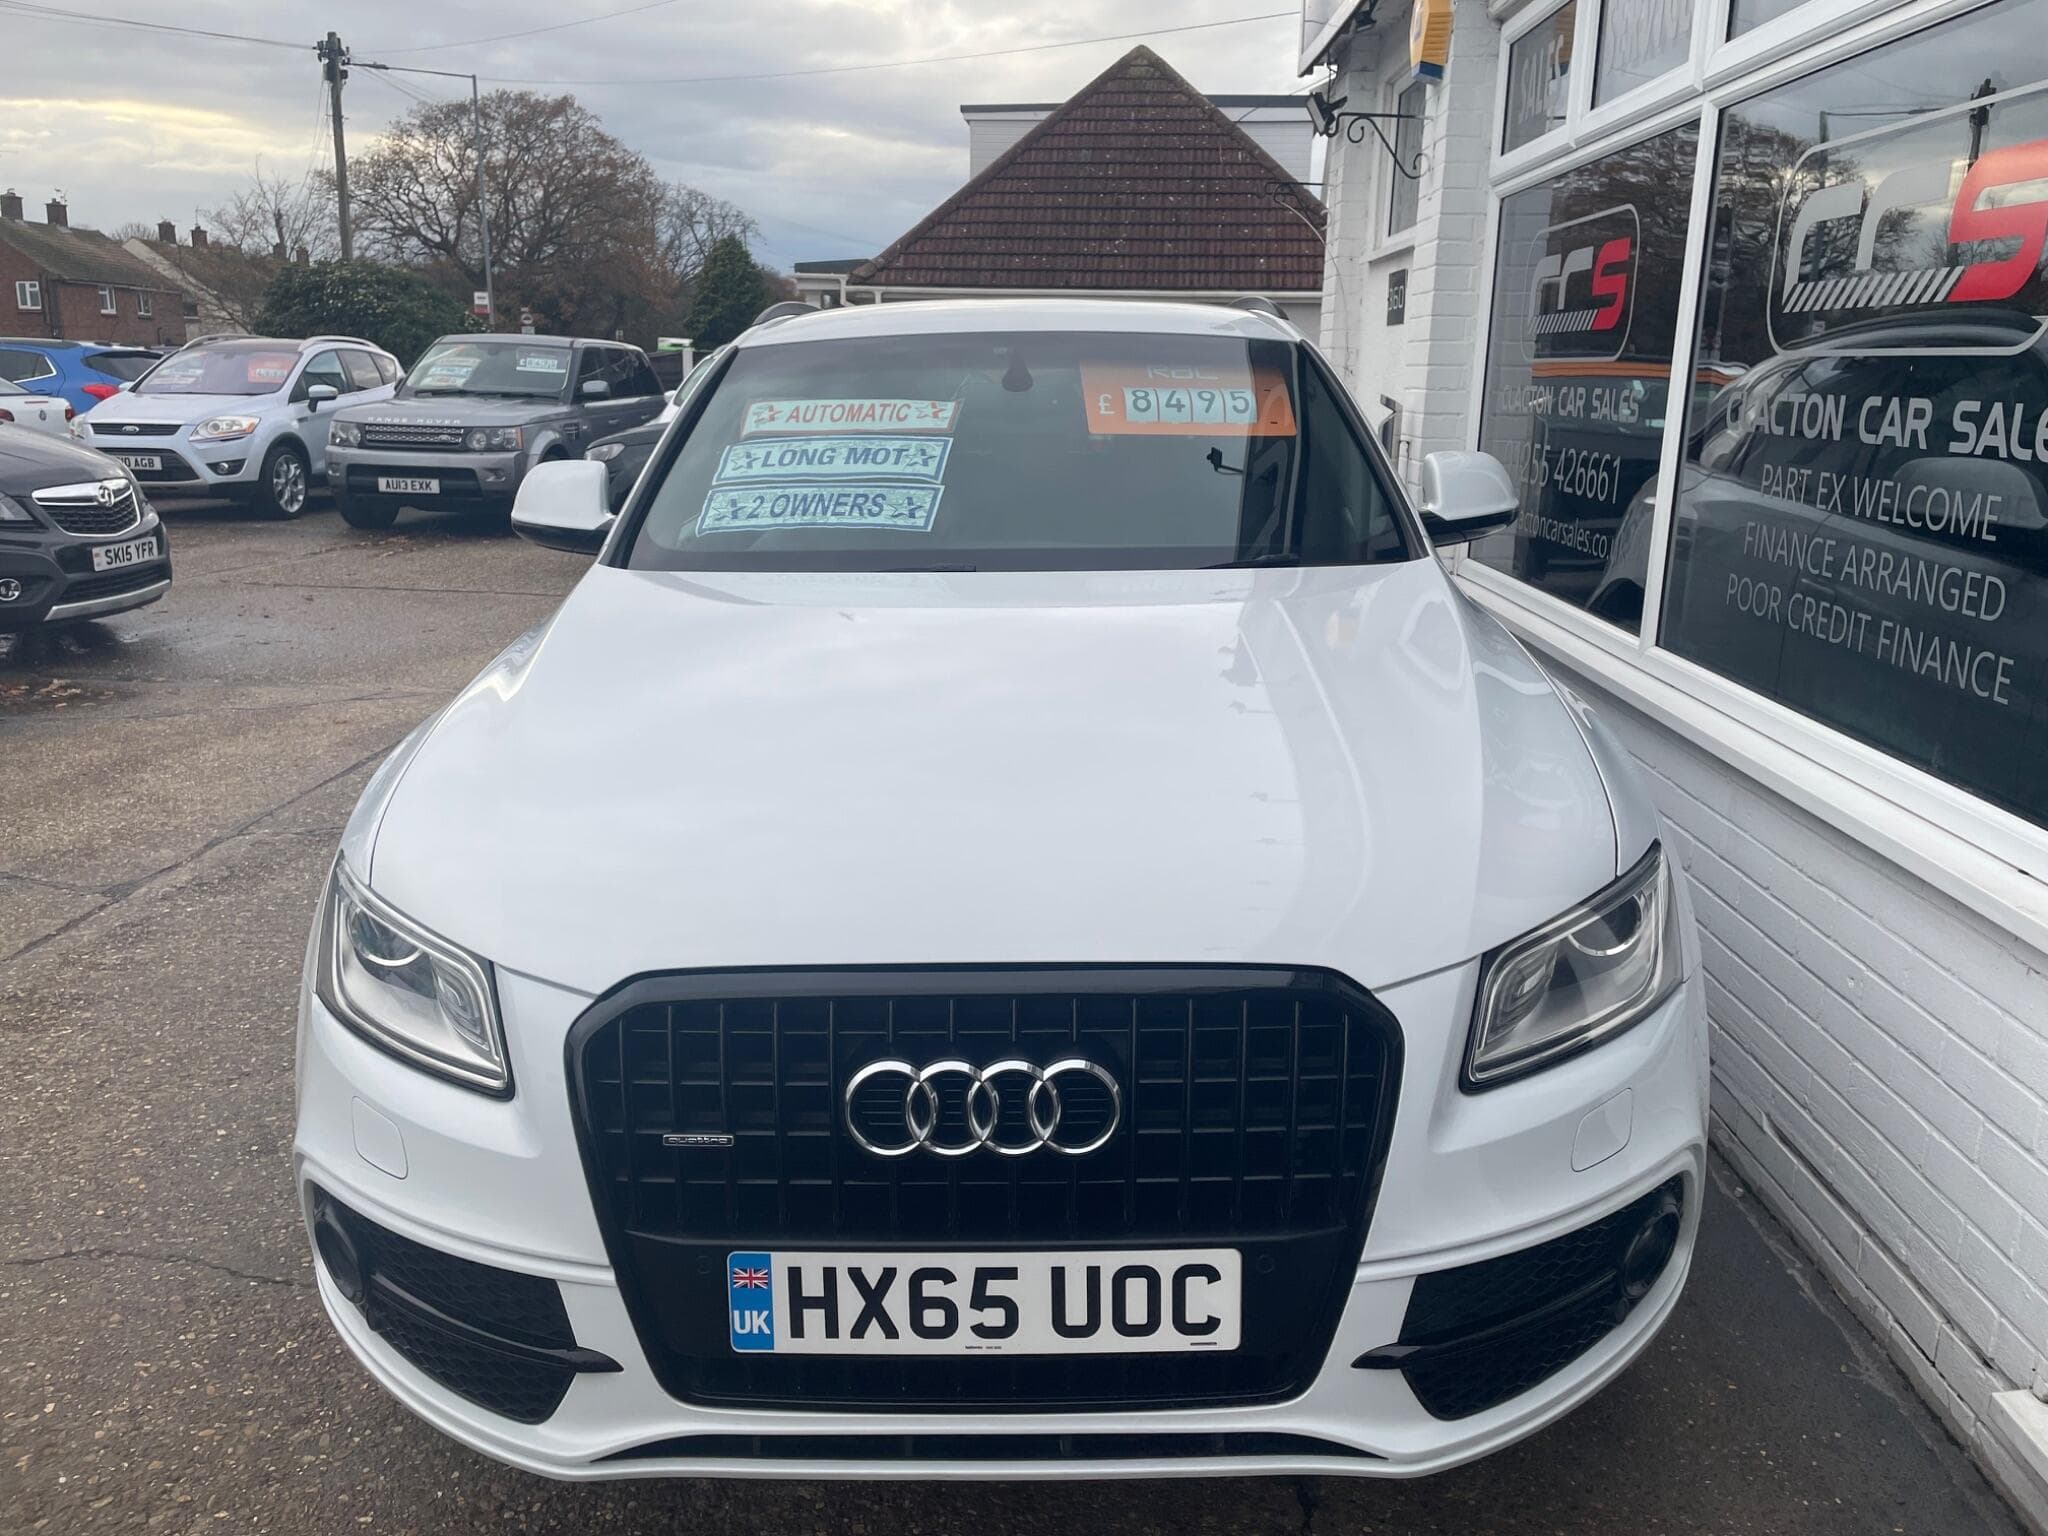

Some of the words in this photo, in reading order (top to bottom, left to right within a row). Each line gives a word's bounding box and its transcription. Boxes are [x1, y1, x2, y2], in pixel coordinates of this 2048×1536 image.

[1388, 285, 1404, 310] 360
[785, 403, 913, 423] AUTOMATIC
[1131, 389, 1251, 413] 8495
[1502, 385, 1554, 414] CLACTON
[1558, 386, 1587, 418] CAR
[1590, 388, 1640, 423] SALES
[1726, 391, 1847, 442] CLACTON
[1858, 396, 1934, 450] CAR
[134, 457, 155, 468] AGB
[760, 448, 836, 468] LONG
[843, 447, 910, 465] MOT
[385, 477, 408, 490] AU13
[411, 479, 432, 491] EXK
[1553, 448, 1622, 504] 426661
[746, 495, 765, 519] 2
[769, 493, 887, 518] OWNERS
[1760, 464, 1812, 505] PART
[1816, 471, 1847, 513] EX
[1854, 476, 2002, 542] WELCOME
[104, 546, 133, 566] SK15
[135, 541, 154, 560] YFR
[1744, 521, 1837, 579] FINANCE
[1840, 545, 2006, 622] ARRANGED
[1726, 573, 1782, 625] POOR
[1788, 592, 1872, 653] CREDIT
[1877, 620, 2015, 706] FINANCE
[733, 1310, 772, 1335] UK
[787, 1266, 1020, 1340] HX65
[1050, 1263, 1222, 1338] UOC
